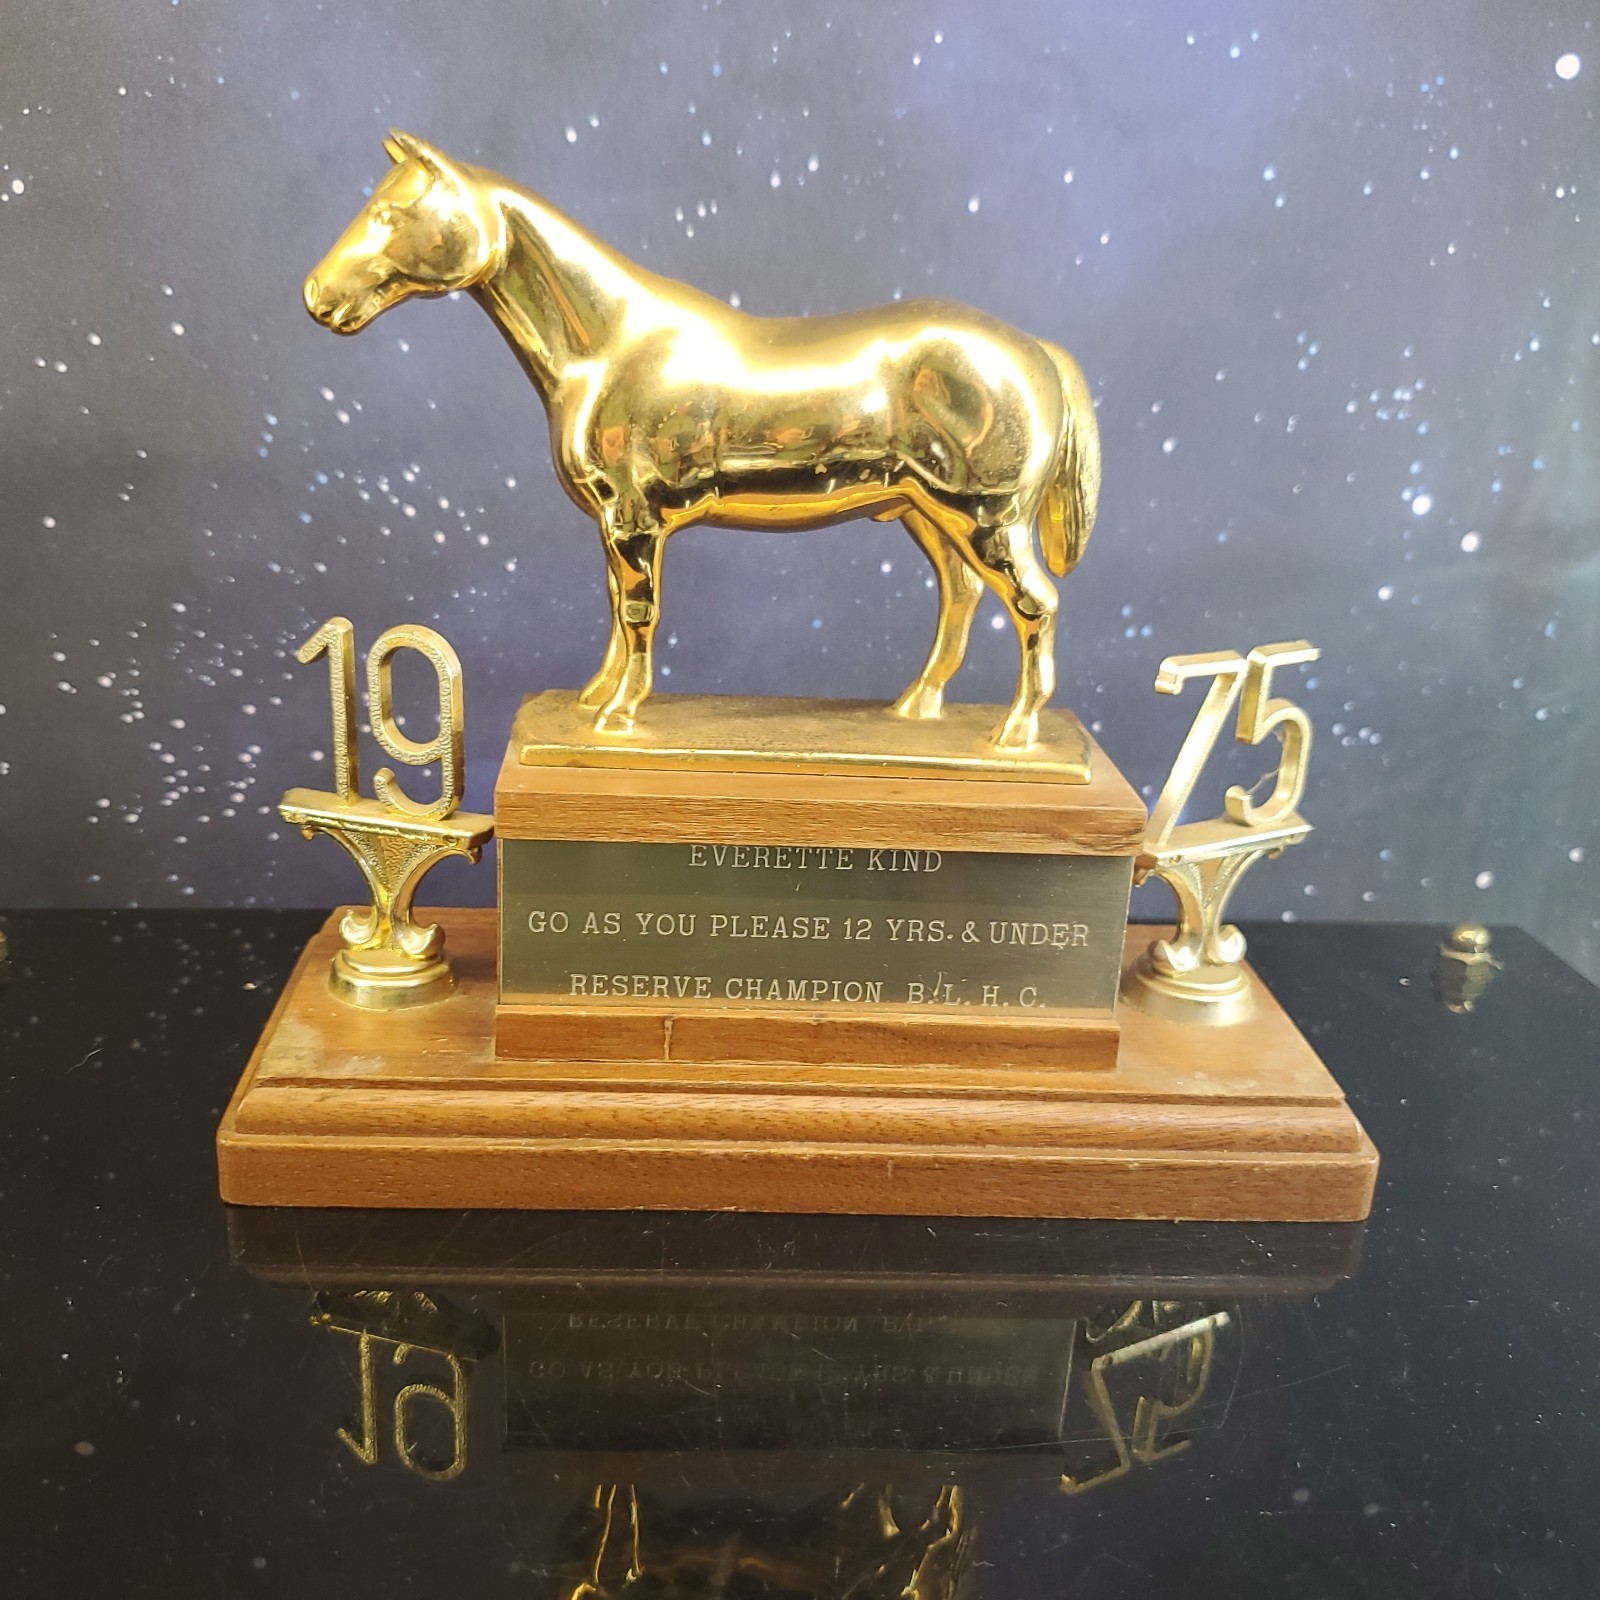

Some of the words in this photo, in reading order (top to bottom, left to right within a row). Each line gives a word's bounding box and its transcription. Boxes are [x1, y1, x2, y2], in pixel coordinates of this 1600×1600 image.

[295, 616, 465, 822] 19
[1143, 639, 1321, 853] 75
[688, 845, 854, 871] EVERETTE
[867, 849, 943, 873] KIND
[528, 910, 569, 934] GO
[582, 911, 622, 935] AS
[635, 912, 696, 937] YOU
[709, 914, 830, 940] PLEASE
[843, 917, 873, 941] 12
[886, 918, 954, 943] YRS.
[961, 920, 981, 944] &
[989, 921, 1089, 948] UNDER
[569, 973, 712, 999] RESERVE
[725, 977, 884, 1003] CHAMPION
